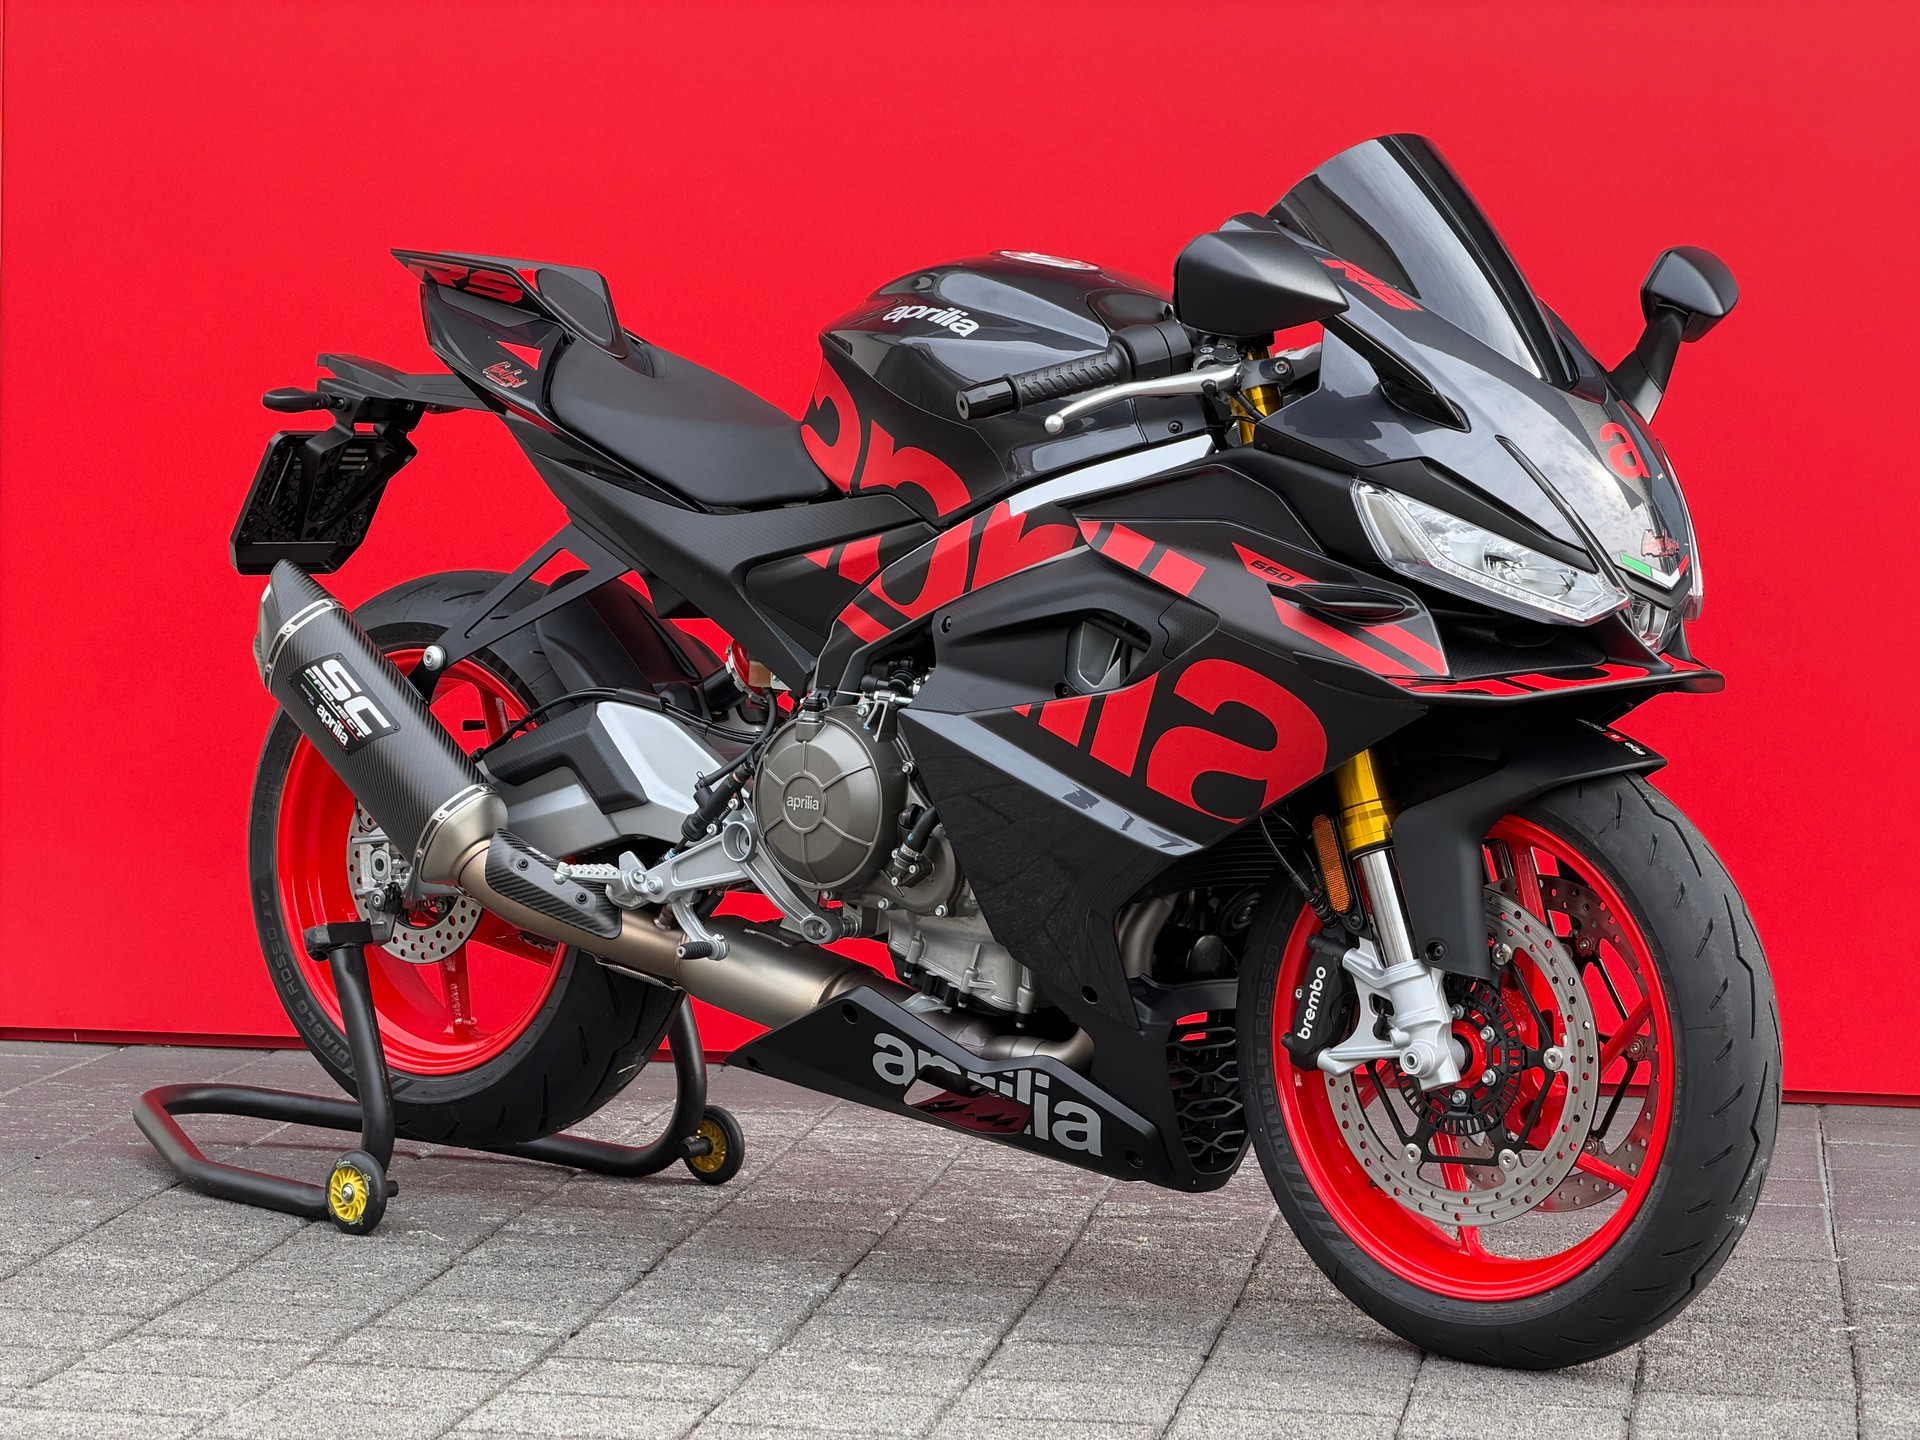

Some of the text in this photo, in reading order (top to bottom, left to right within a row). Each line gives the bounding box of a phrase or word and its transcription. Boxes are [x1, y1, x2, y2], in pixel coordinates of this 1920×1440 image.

[882, 304, 979, 338] aprilia
[1600, 422, 1650, 478] a
[1249, 559, 1295, 582] 660
[304, 668, 366, 738] PROJECT
[311, 659, 392, 736] SC
[316, 704, 349, 746] aprilia
[786, 795, 819, 811] aprilia
[267, 926, 300, 996] ROSSO
[1254, 944, 1281, 1036] ROSSO
[299, 1000, 350, 1064] DIABLO
[1297, 965, 1328, 1041] brembo
[1255, 1053, 1290, 1157] DIABLO
